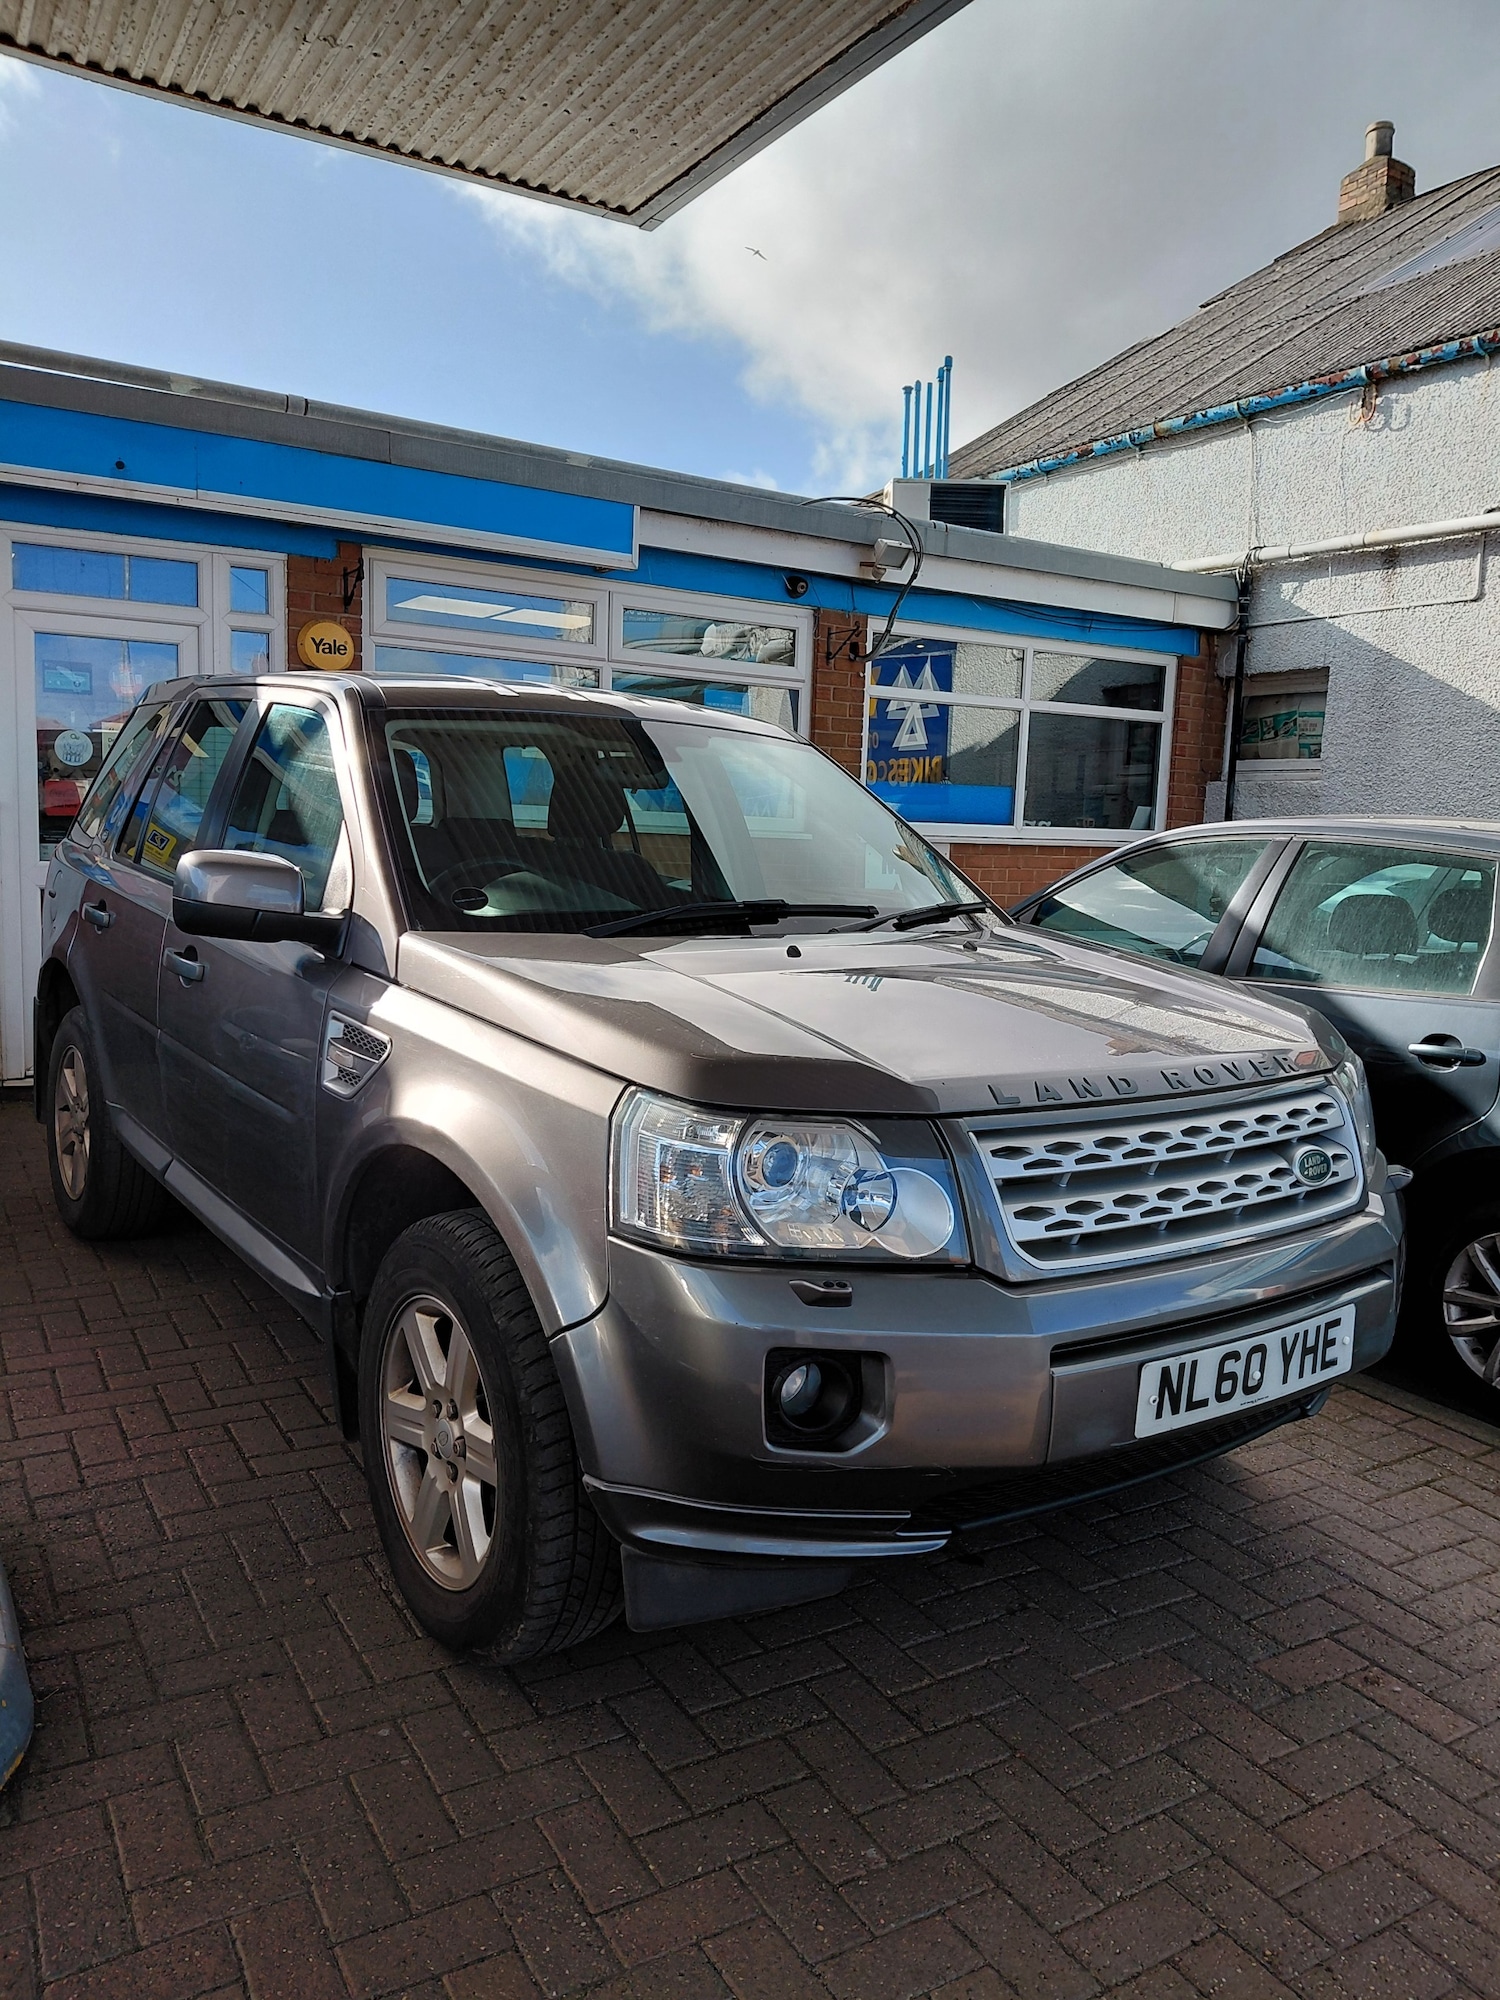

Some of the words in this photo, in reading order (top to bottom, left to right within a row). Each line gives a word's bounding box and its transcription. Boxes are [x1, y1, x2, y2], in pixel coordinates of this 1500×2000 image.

[310, 636, 348, 656] Yale
[987, 1074, 1139, 1105] LAND
[1160, 1053, 1300, 1090] ROVER
[1304, 1155, 1321, 1168] LAND
[1308, 1163, 1328, 1177] ROVER
[1155, 1343, 1267, 1420] NL60
[1281, 1317, 1342, 1386] YHE
